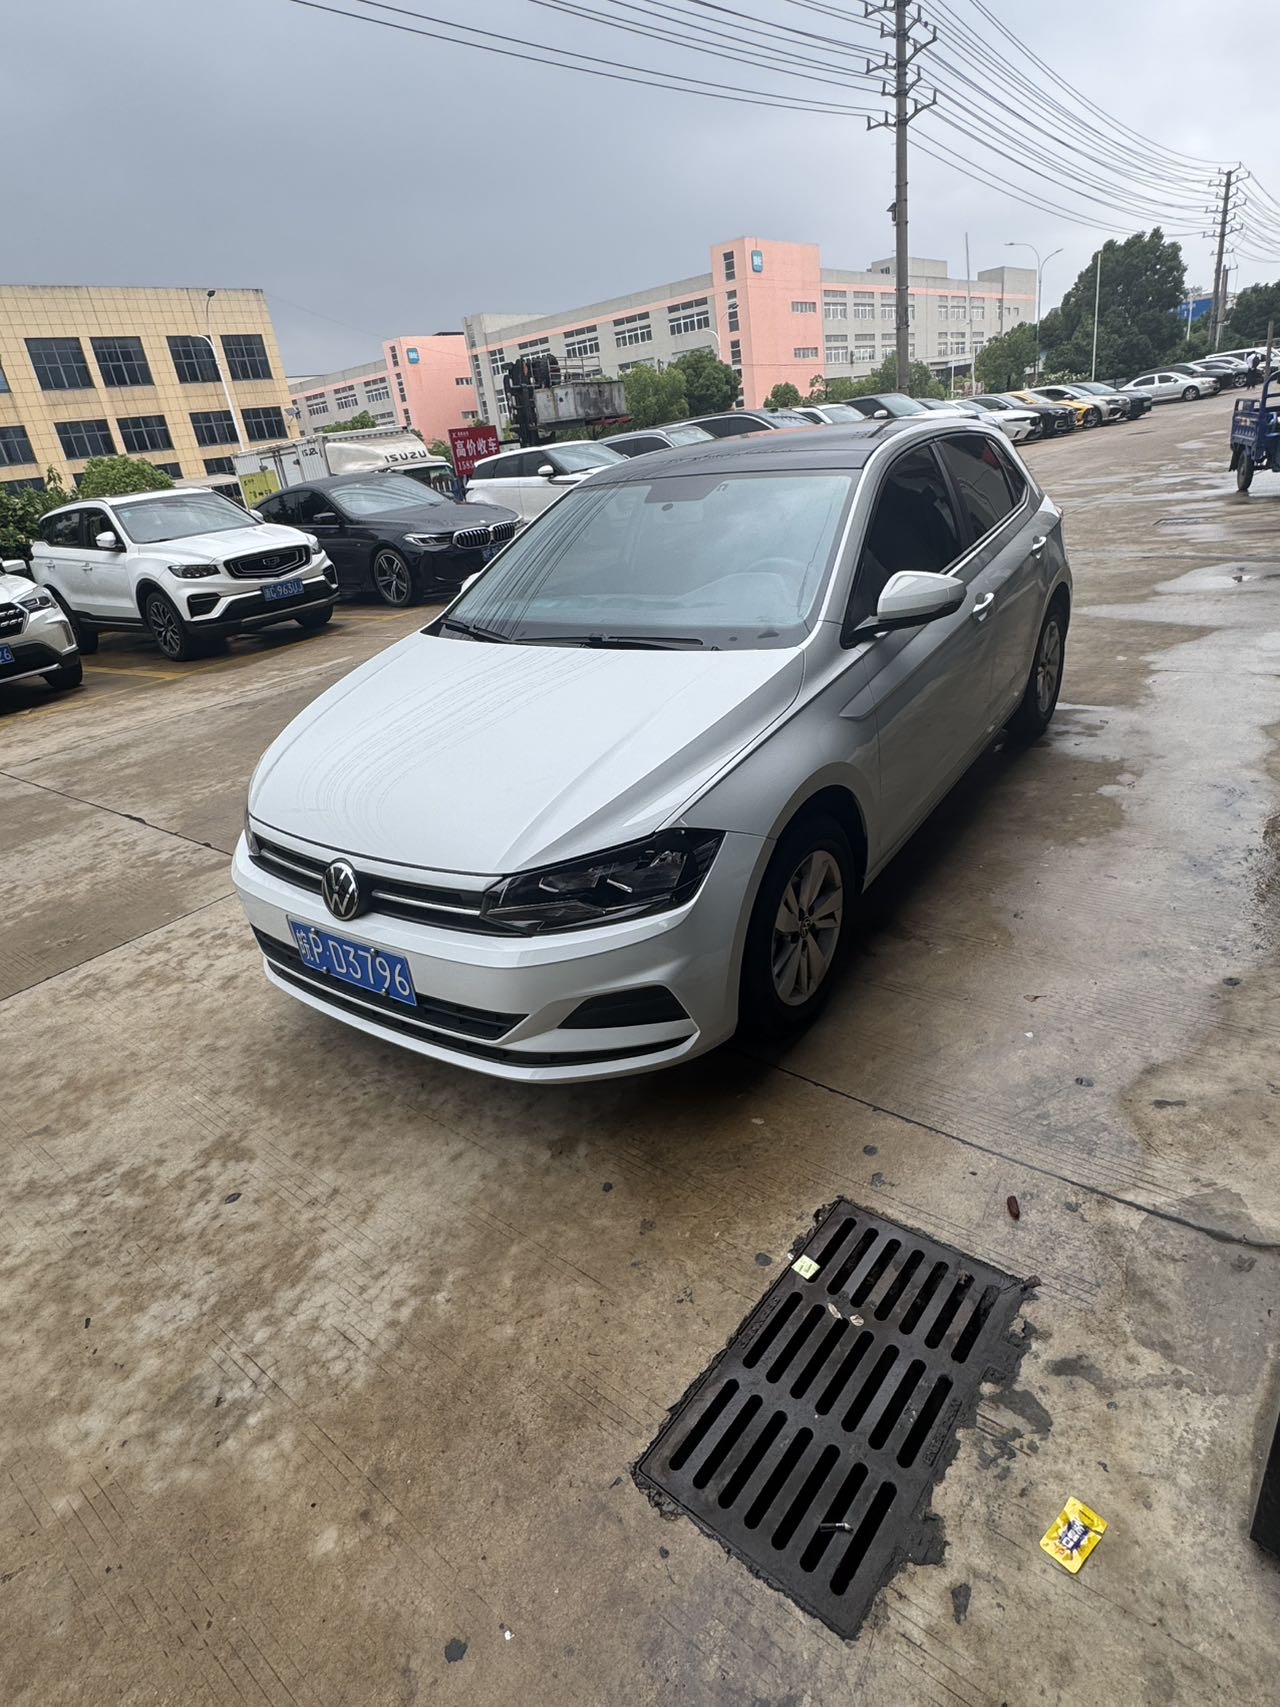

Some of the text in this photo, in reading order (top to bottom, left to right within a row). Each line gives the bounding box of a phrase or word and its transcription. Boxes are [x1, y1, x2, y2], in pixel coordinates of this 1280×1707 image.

[455, 436, 498, 458] 高价收车
[384, 450, 427, 463] ISUZU
